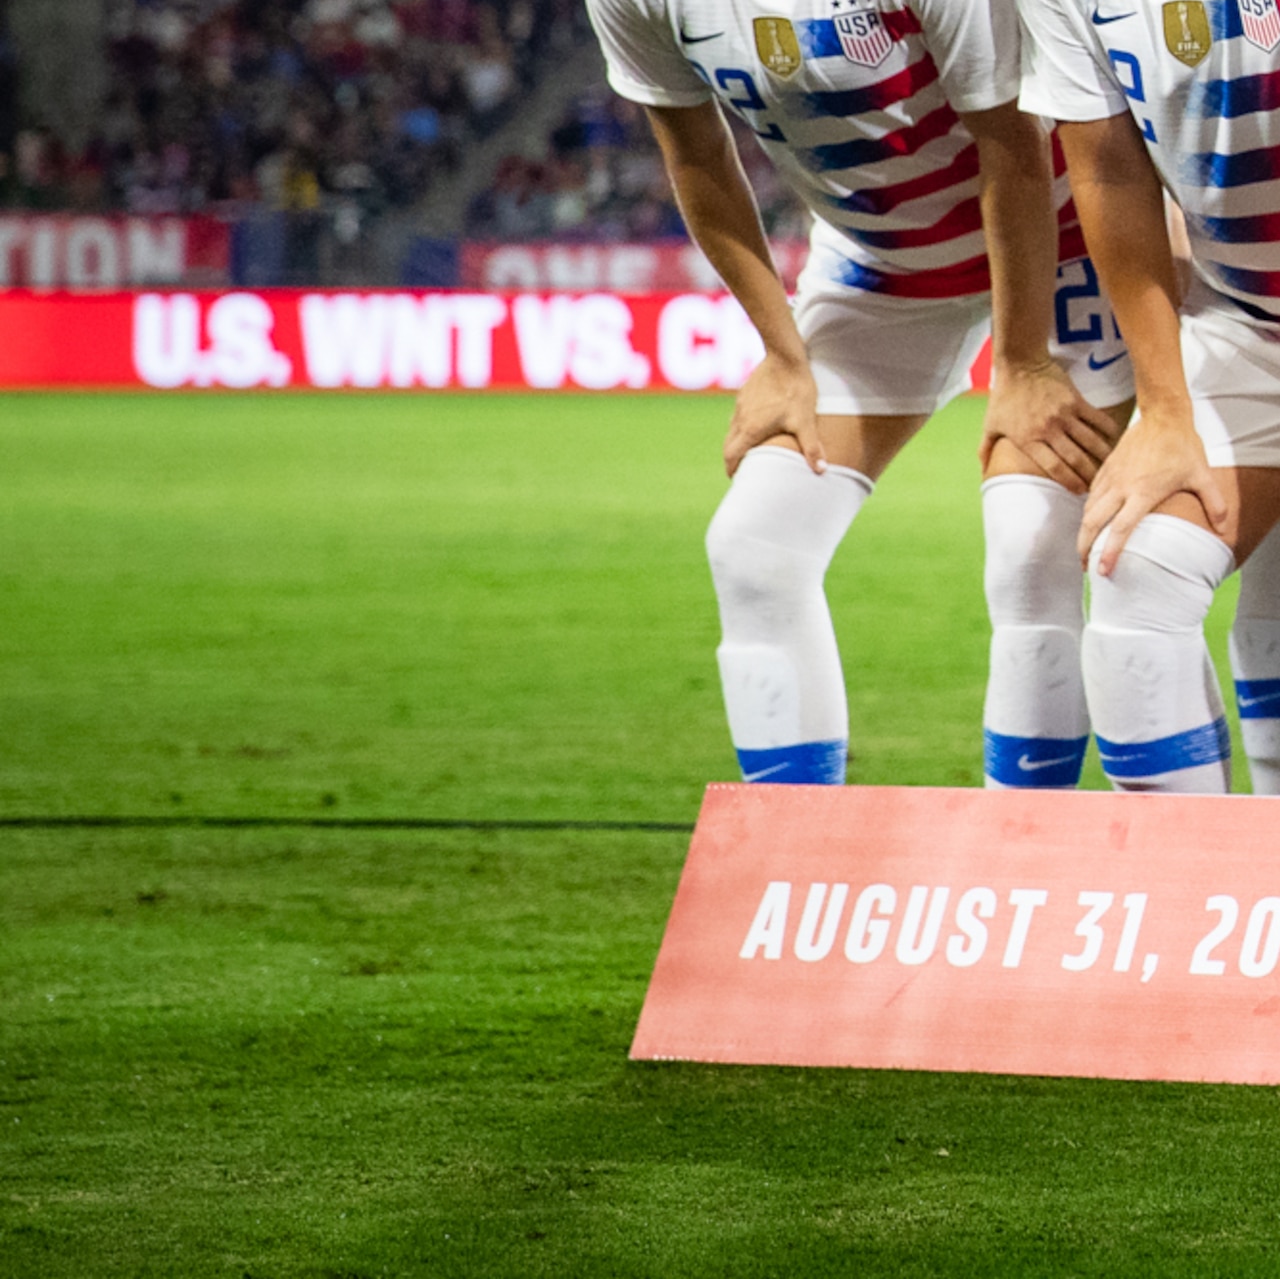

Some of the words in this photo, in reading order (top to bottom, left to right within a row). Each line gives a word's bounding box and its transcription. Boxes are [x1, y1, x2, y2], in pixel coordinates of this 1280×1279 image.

[838, 11, 881, 37] USA
[133, 292, 292, 388] U.S.
[298, 292, 505, 388] WNT
[512, 293, 651, 388] VS.
[740, 881, 1048, 969] AUGUST
[1060, 891, 1160, 982] 31,
